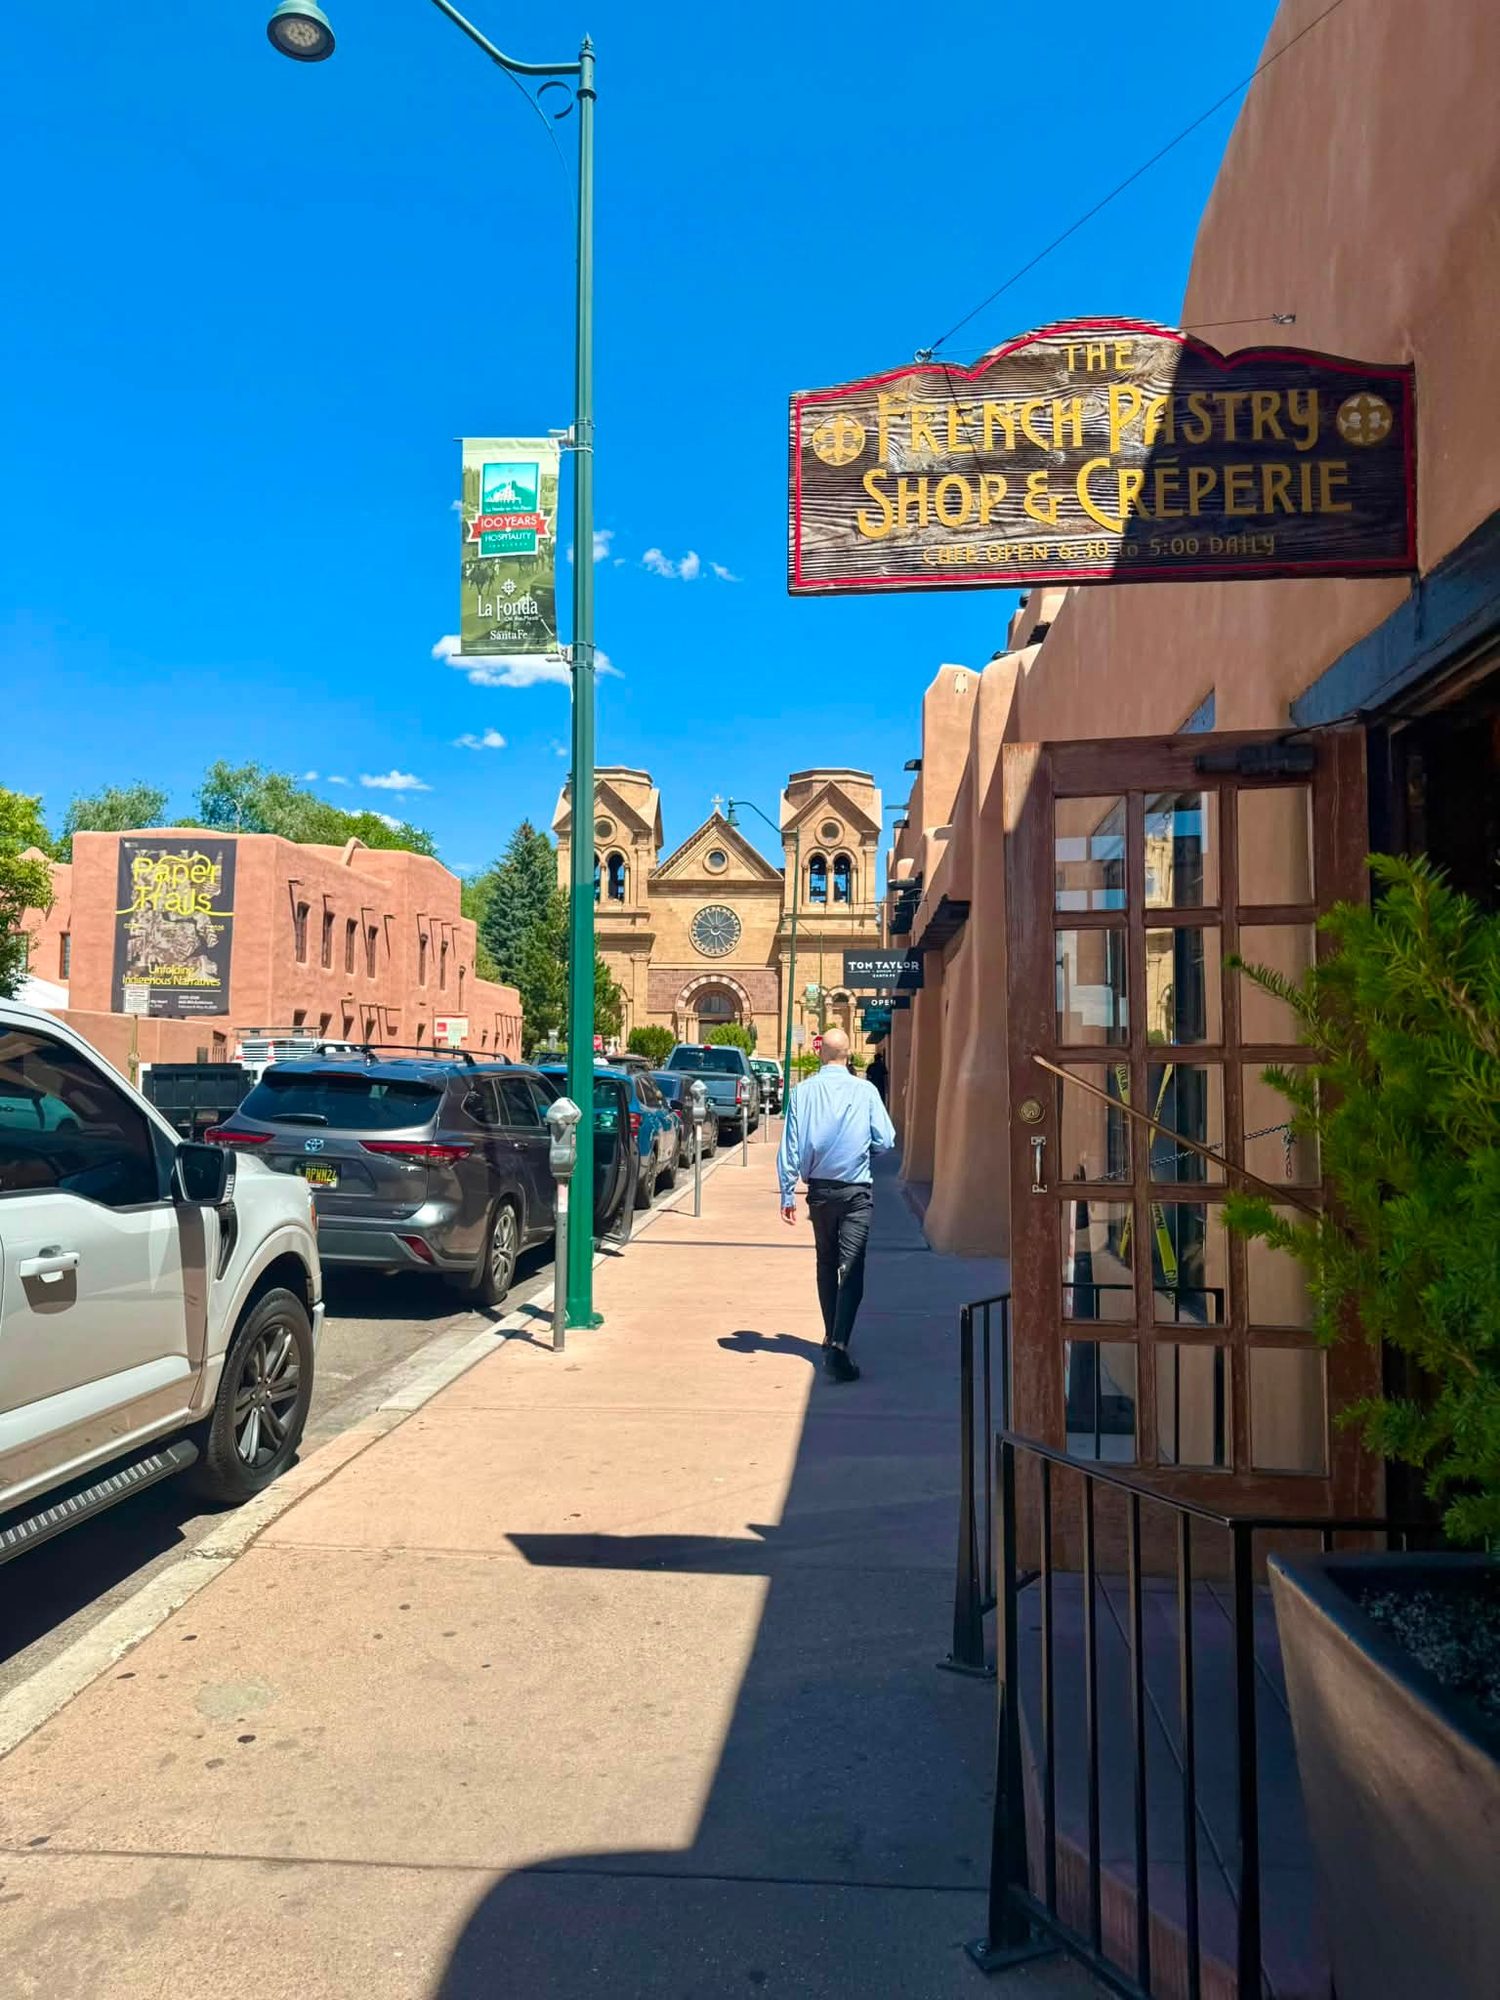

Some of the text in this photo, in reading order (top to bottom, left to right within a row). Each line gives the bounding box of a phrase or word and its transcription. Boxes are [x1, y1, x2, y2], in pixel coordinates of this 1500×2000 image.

[1063, 341, 1135, 372] THE
[877, 383, 1319, 463] FRENCH PASTRY
[857, 467, 1009, 539] SHOP
[1023, 469, 1064, 526] &
[481, 515, 537, 529] 100 YEARS
[484, 531, 532, 542] HOSPITALITY
[986, 543, 1048, 563] OPEN
[1149, 538, 1200, 557] 5:00
[1209, 534, 1276, 556] DAILY
[477, 591, 539, 622] La Fonda
[490, 629, 528, 641] Santa Fe
[133, 857, 220, 889] Paper
[134, 886, 212, 916] Trails
[148, 961, 196, 977] Unfolding
[847, 961, 920, 970] TOM TAYLOR
